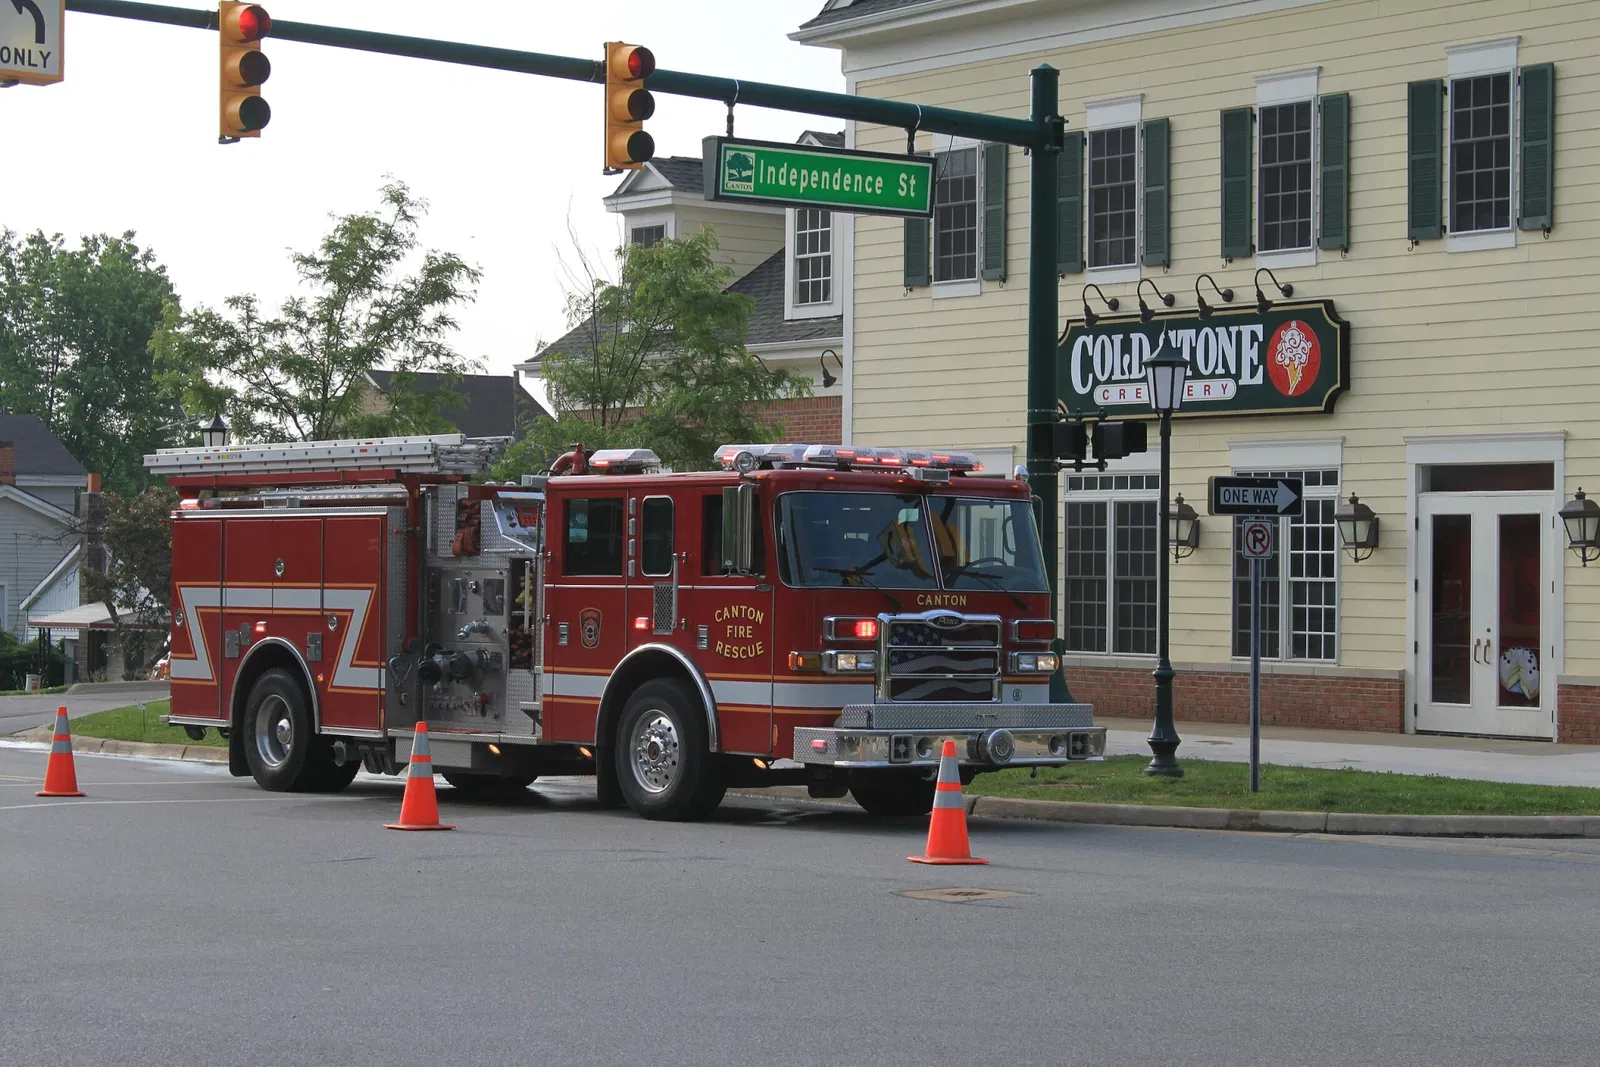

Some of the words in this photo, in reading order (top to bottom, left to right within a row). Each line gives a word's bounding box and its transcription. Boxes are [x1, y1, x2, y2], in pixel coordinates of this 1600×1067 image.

[0, 46, 51, 68] ONLY
[759, 159, 883, 195] Independence
[898, 172, 917, 197] St
[1070, 332, 1151, 395] COLD
[1102, 383, 1228, 400] CREERY
[1223, 488, 1249, 503] ONE
[1252, 489, 1278, 504] WAY
[916, 594, 967, 606] CANTON
[714, 605, 764, 624] CANTON
[726, 625, 753, 638] FIRE
[715, 640, 764, 659] RESCUE
